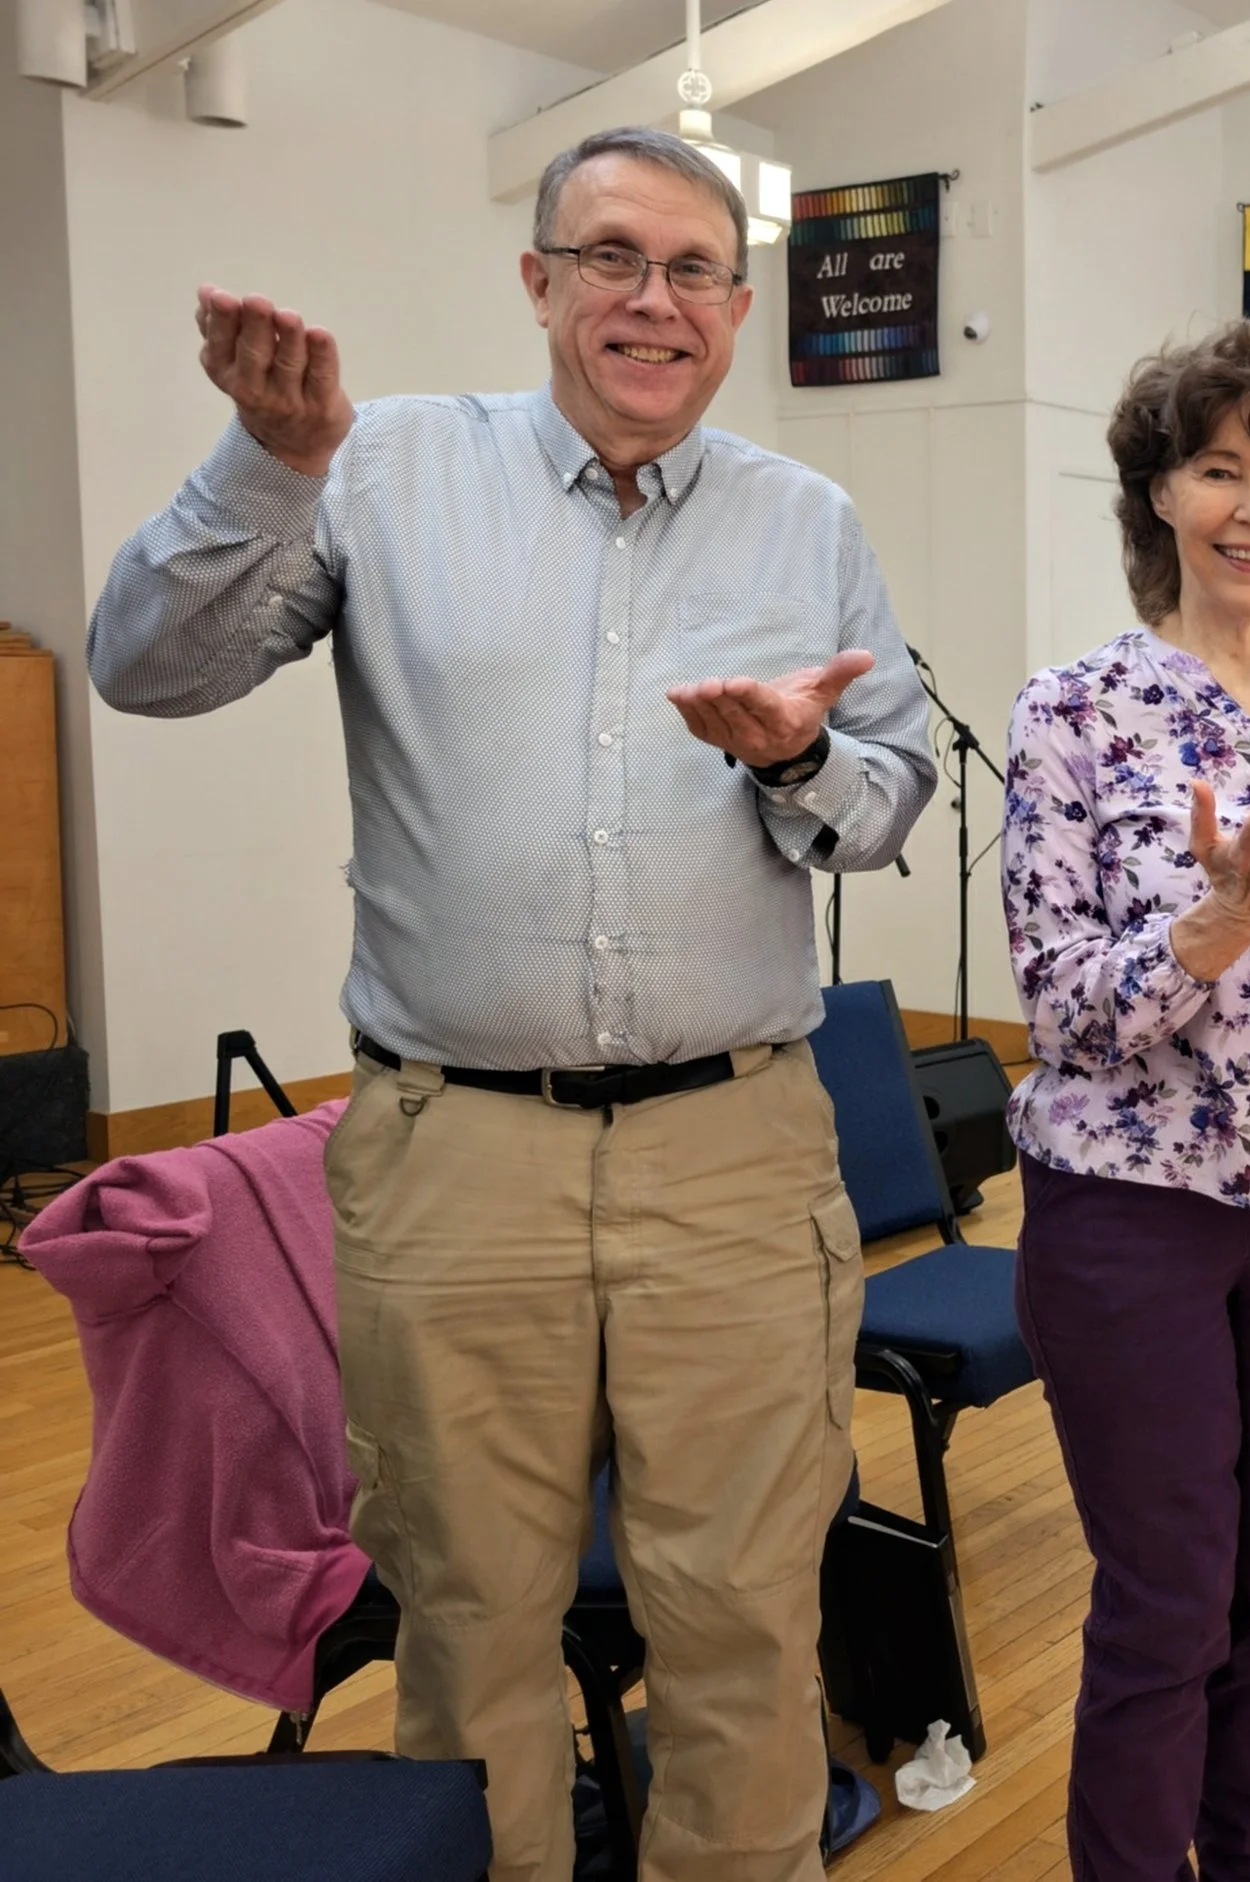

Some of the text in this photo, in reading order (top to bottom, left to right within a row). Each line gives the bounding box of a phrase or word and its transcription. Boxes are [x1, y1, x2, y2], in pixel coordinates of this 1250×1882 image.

[817, 251, 905, 279] All are
[821, 293, 912, 318] Welcome
